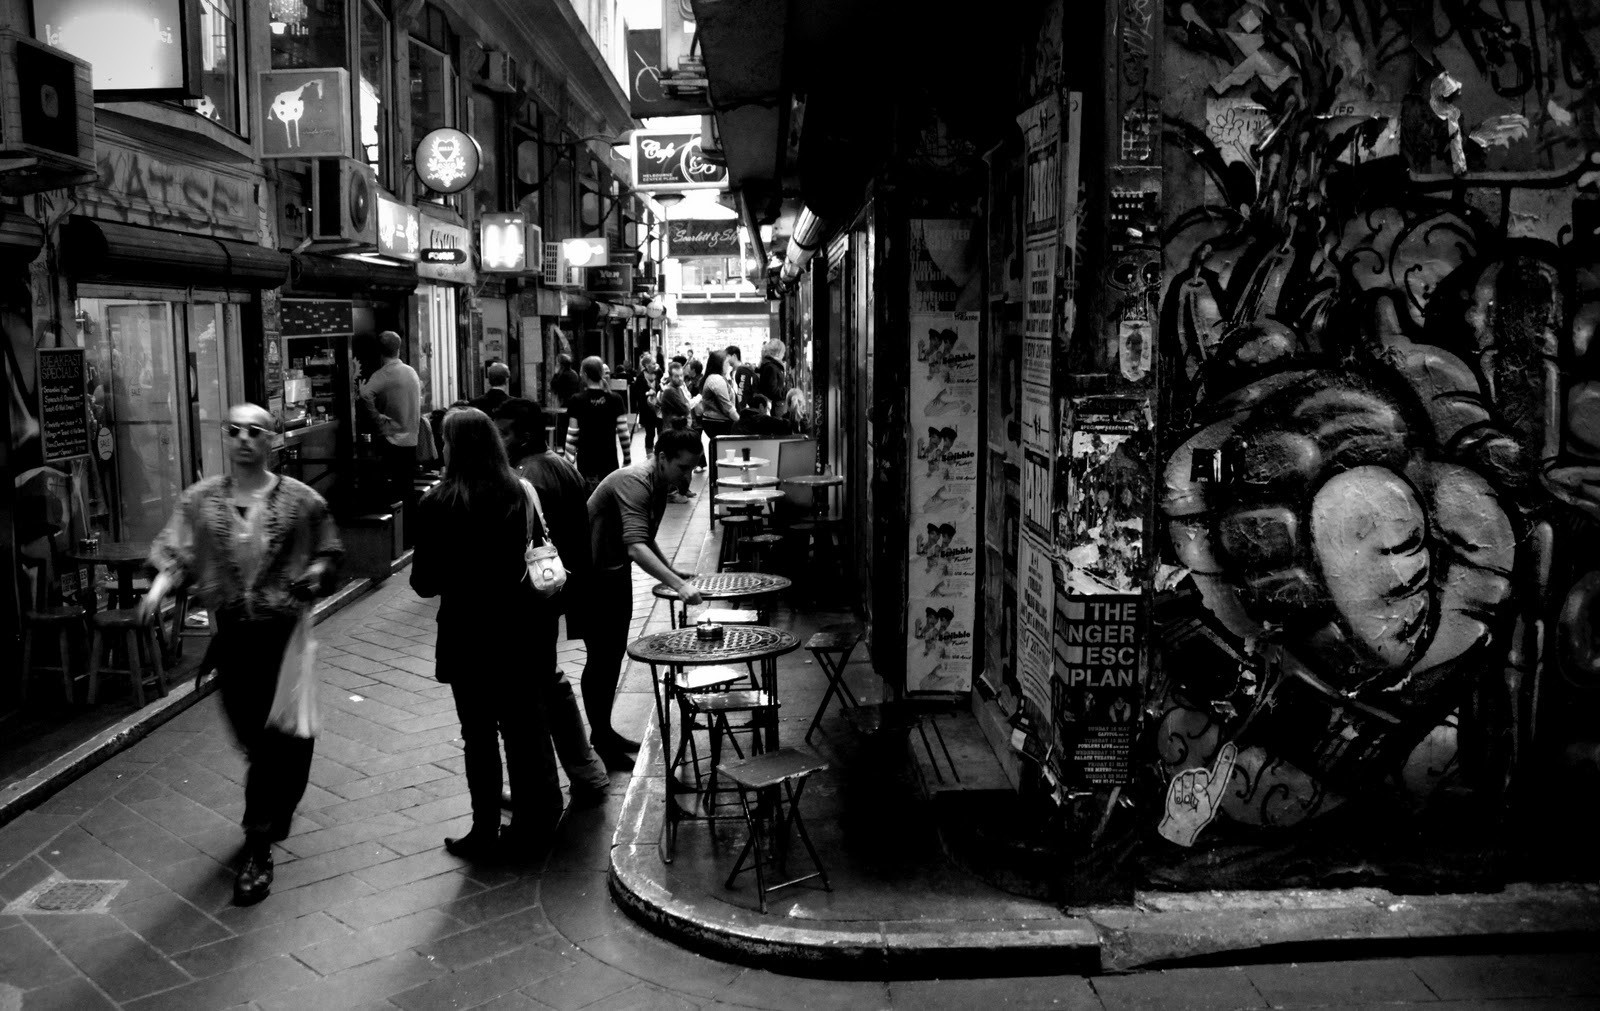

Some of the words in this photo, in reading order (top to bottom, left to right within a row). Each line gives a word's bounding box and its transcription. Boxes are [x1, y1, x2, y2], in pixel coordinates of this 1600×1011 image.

[673, 229, 712, 243] Scarlett
[709, 232, 720, 248] &
[41, 353, 81, 367] BREAKFAST
[42, 366, 80, 380] SPECIALS
[1089, 602, 1137, 621] THE
[1086, 646, 1135, 666] ESC
[1070, 668, 1133, 687] PLAN
